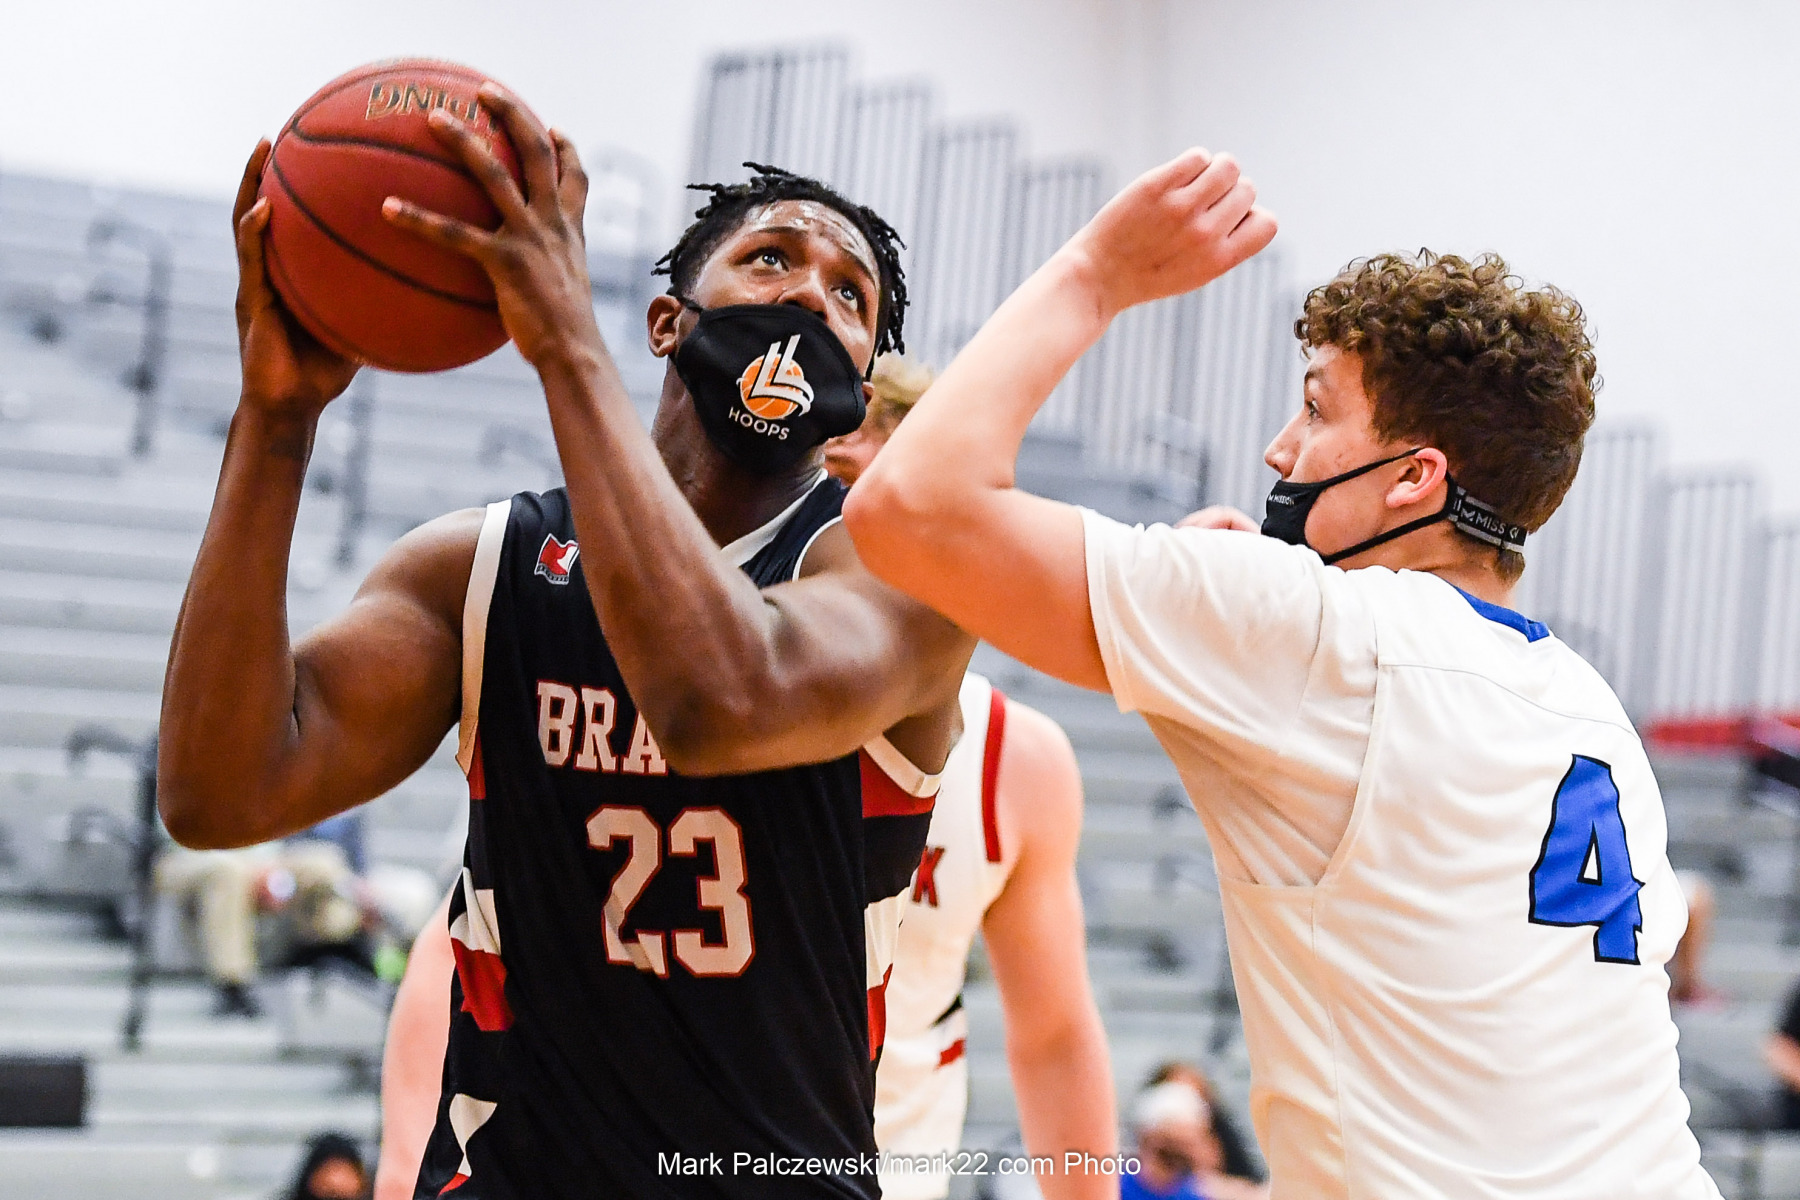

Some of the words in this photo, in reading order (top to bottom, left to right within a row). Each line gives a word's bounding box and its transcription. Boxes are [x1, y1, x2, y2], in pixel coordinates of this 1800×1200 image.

[364, 80, 500, 134] DING
[728, 406, 790, 440] HOOPS
[537, 679, 669, 776] BRA
[585, 803, 755, 979] 23
[911, 844, 945, 908] K
[1528, 753, 1646, 965] 4
